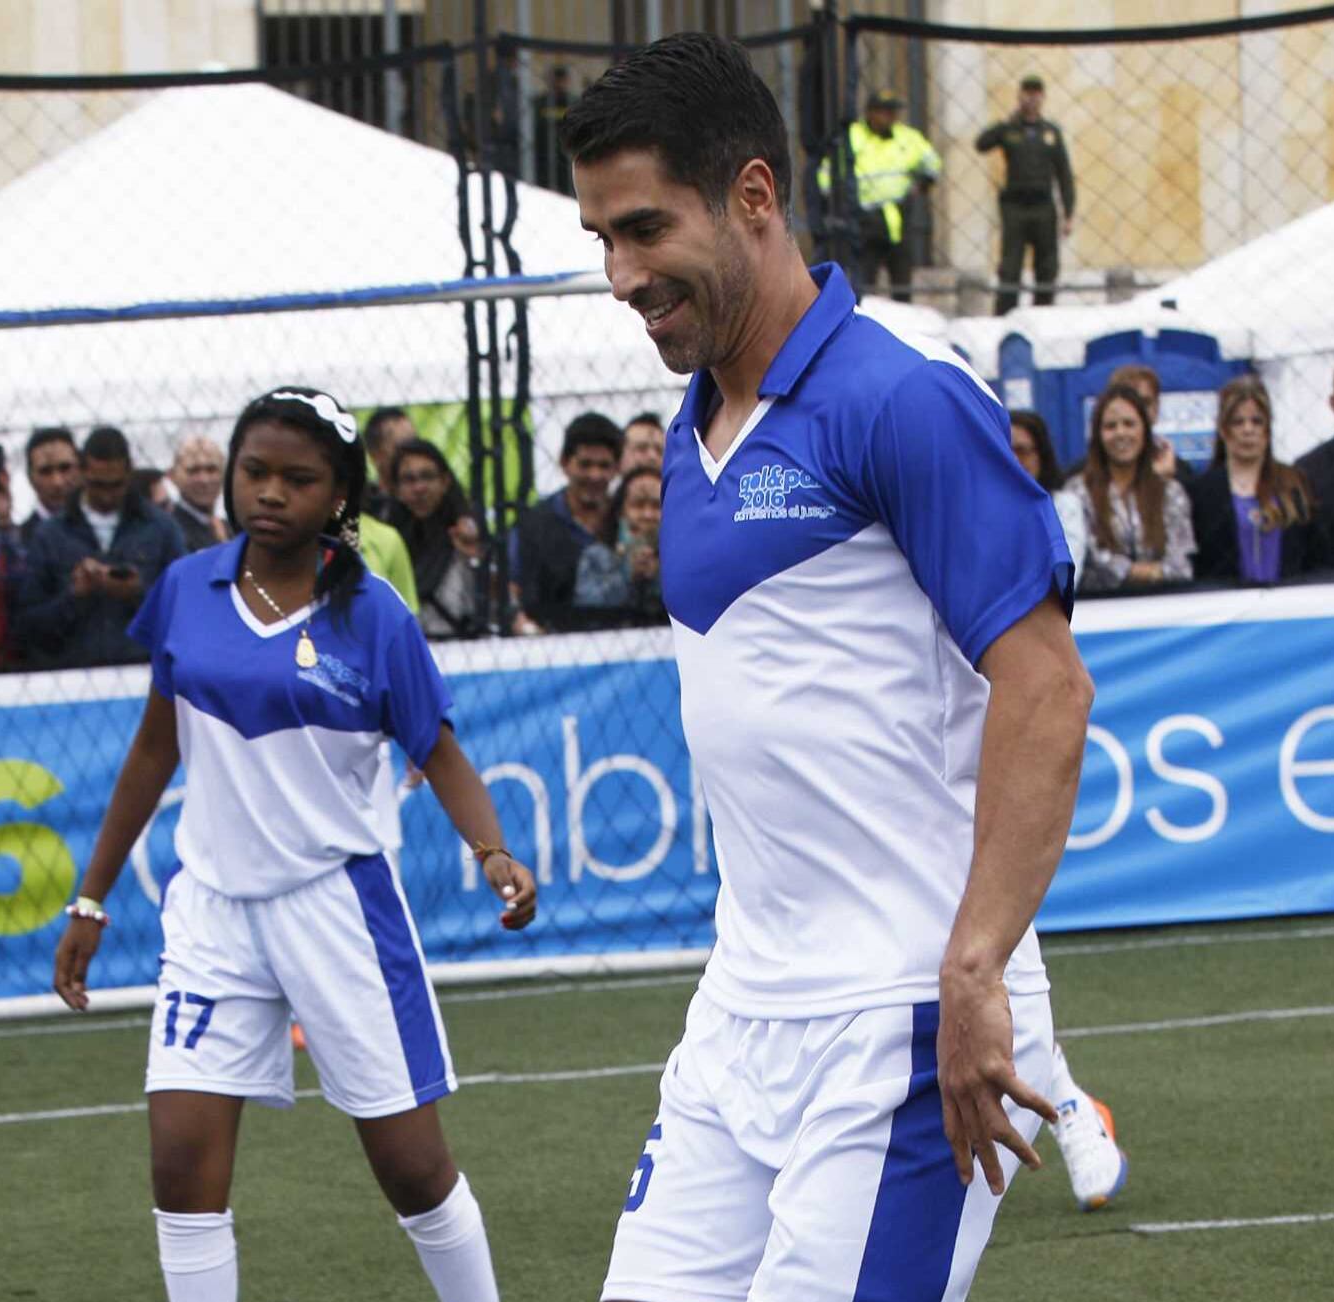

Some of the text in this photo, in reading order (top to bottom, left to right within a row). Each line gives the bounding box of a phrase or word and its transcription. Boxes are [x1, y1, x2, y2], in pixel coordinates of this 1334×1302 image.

[739, 464, 823, 498] gol&pa
[739, 489, 786, 512] 2016
[163, 990, 217, 1050] 17
